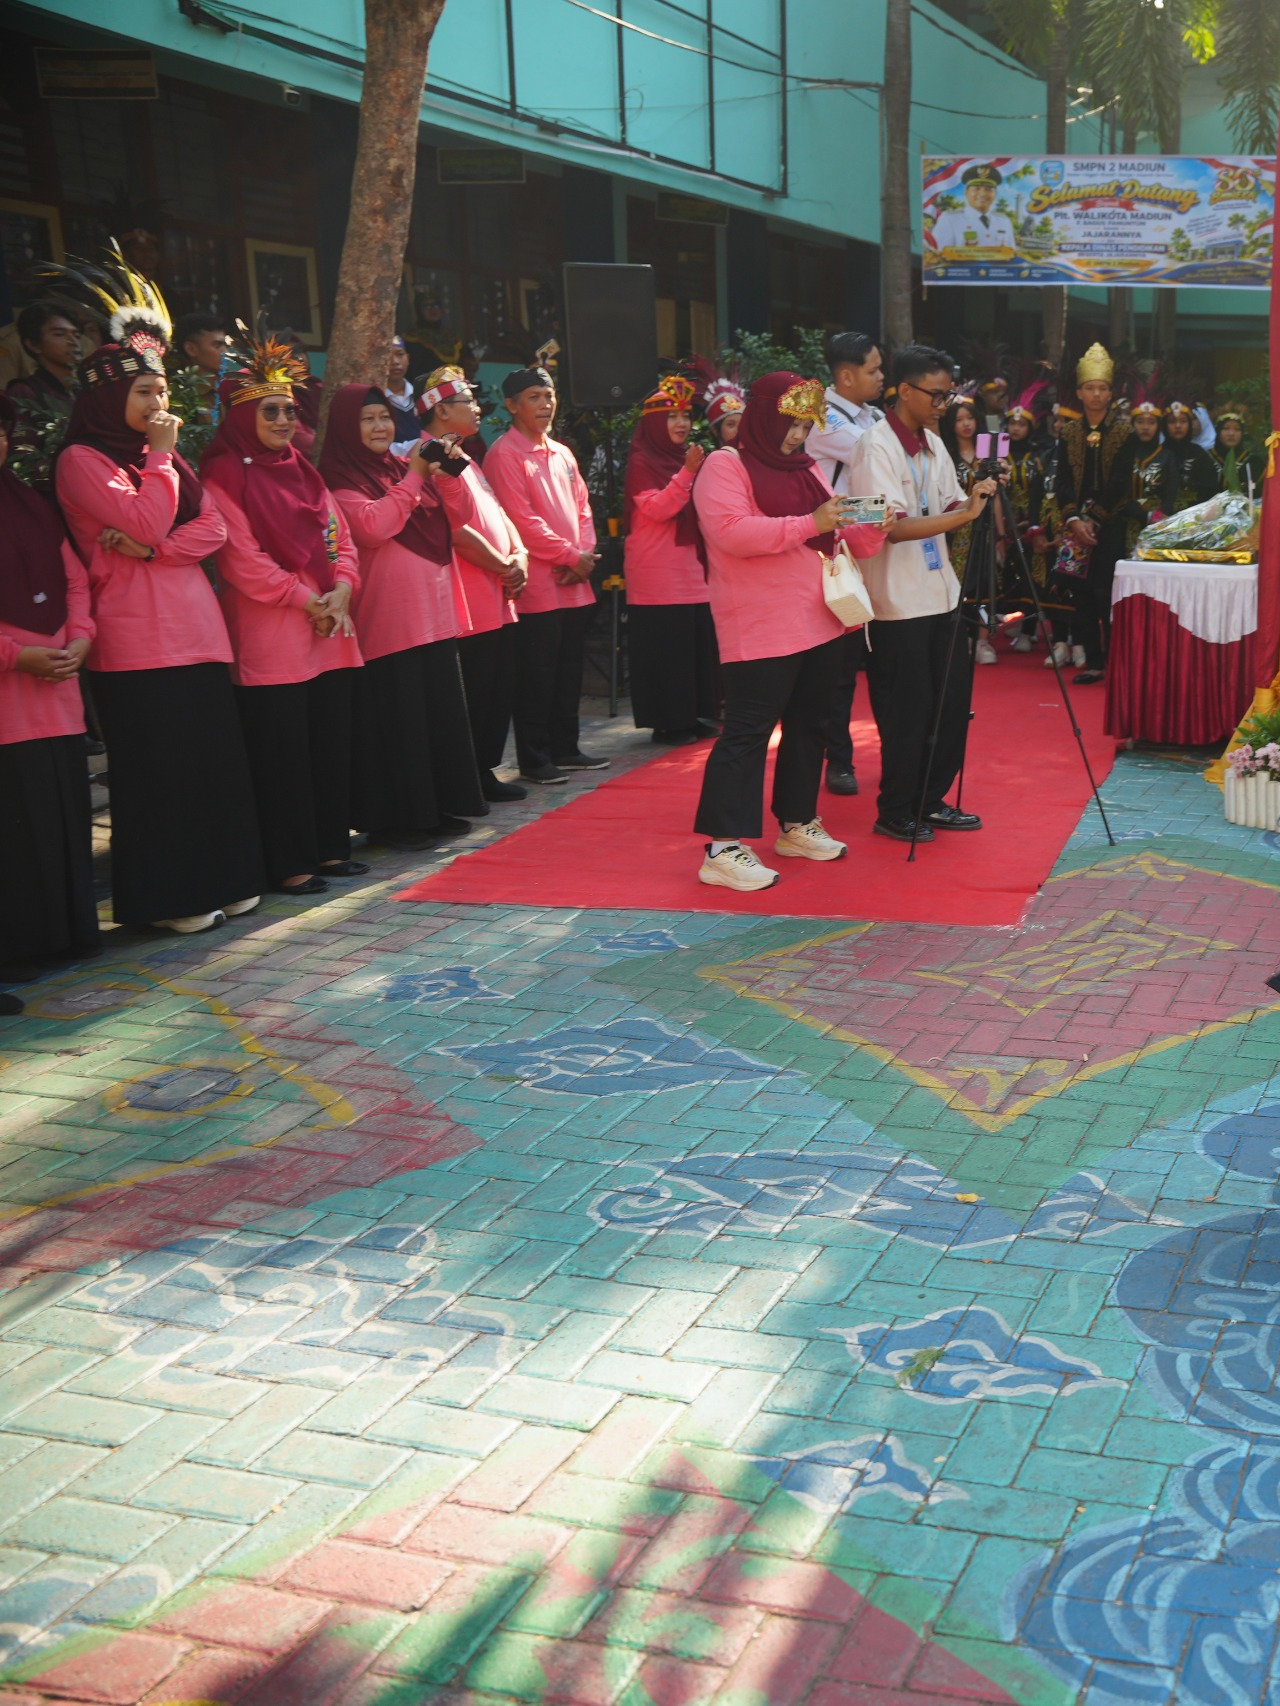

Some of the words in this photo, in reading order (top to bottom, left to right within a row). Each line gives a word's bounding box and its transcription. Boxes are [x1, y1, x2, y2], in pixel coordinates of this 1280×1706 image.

[1072, 162, 1106, 172] SMPN
[1108, 162, 1116, 172] 2
[1118, 162, 1166, 172] MADIUN
[1026, 180, 1120, 213] Selamat
[1121, 179, 1200, 214] Datang
[1073, 211, 1127, 220] WALIKOTA
[1130, 212, 1172, 220] MADIUN
